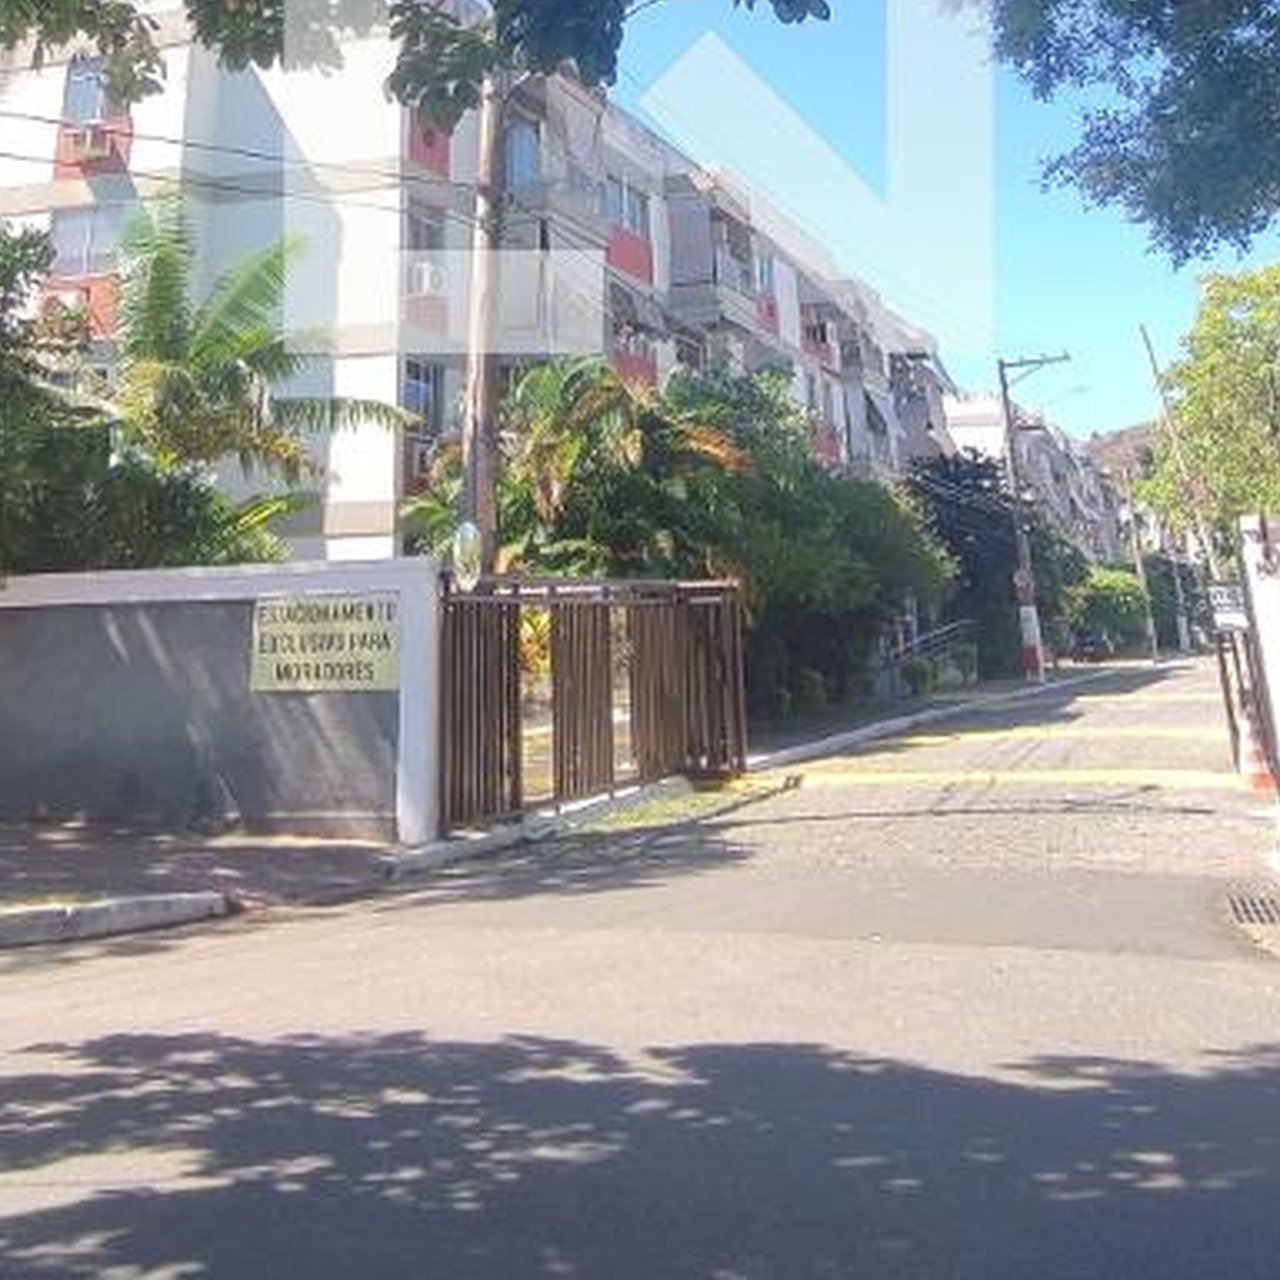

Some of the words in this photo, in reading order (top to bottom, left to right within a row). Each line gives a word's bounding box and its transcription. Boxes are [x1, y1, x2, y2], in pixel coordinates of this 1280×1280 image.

[260, 602, 397, 621] ESTACIONAMENTO
[260, 633, 344, 653] EXCLUSIVO
[349, 632, 391, 651] PARA
[276, 662, 374, 680] MORADORES
